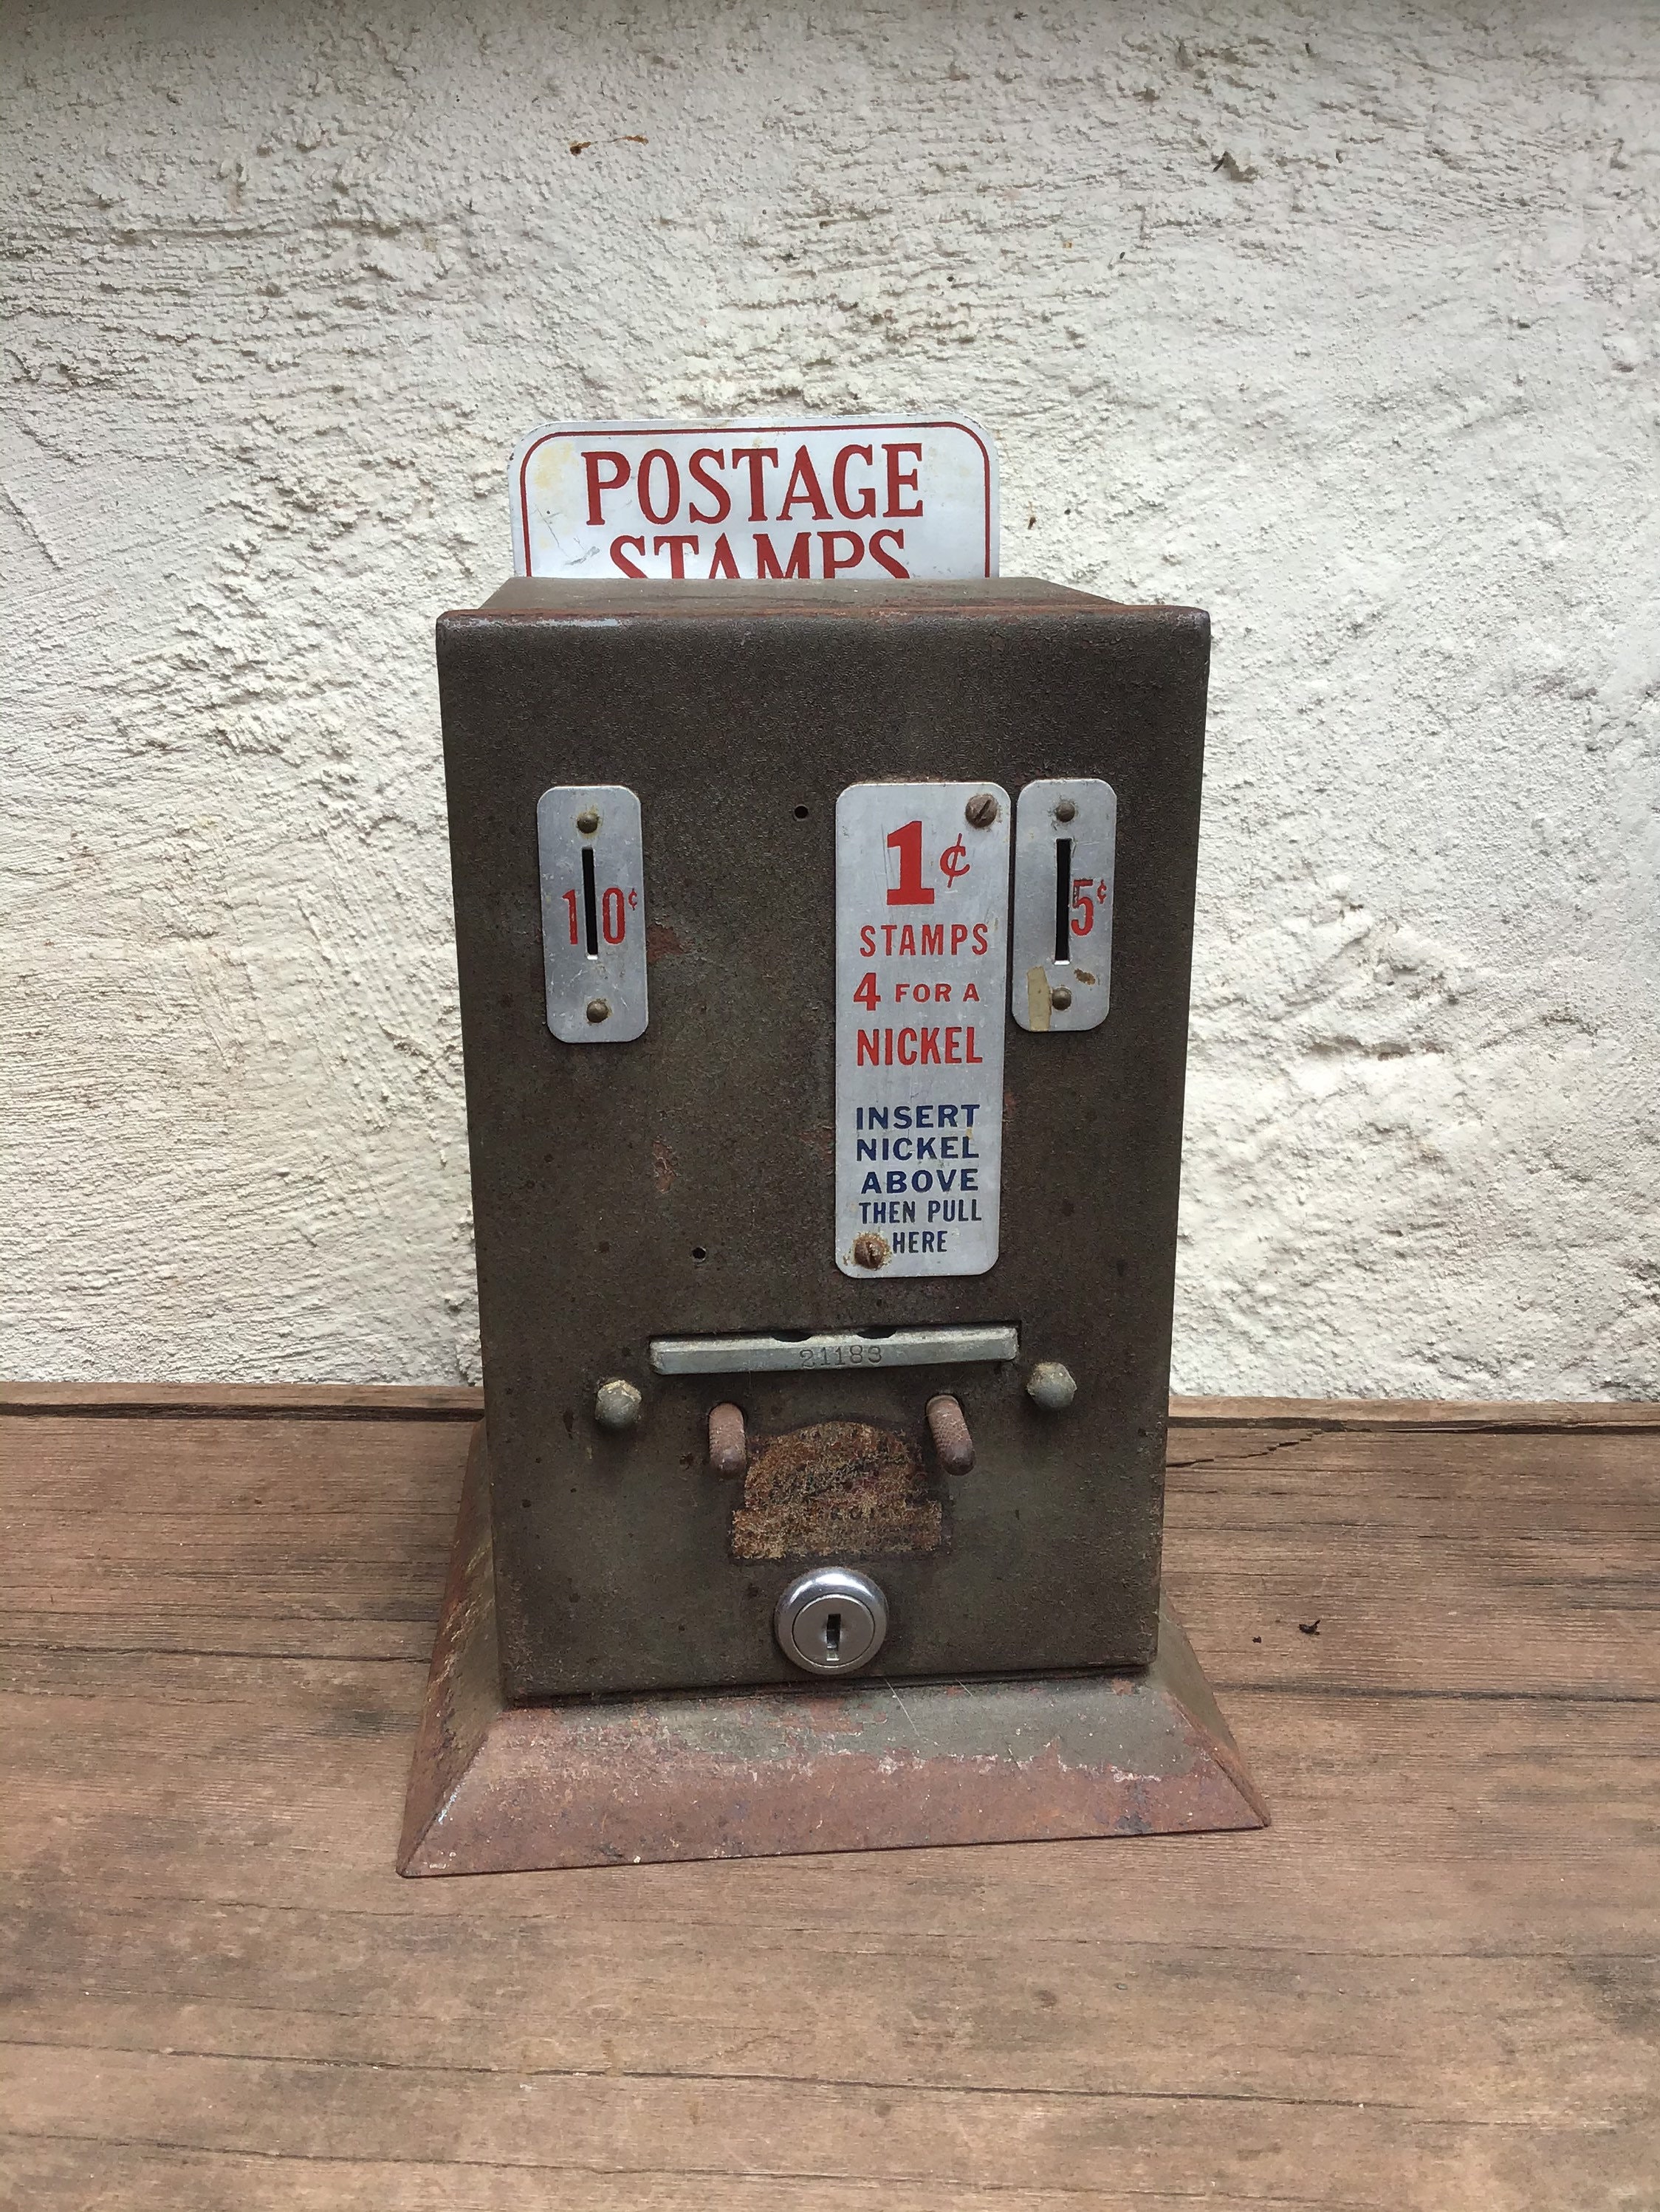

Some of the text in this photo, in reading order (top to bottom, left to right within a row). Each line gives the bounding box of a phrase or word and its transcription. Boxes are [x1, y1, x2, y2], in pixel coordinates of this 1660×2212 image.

[580, 442, 924, 526] POSTAGE
[610, 529, 910, 580] STAMPS
[1071, 879, 1107, 937] 5¢
[860, 923, 988, 957] STAMPS
[853, 972, 980, 1011] 4 FOR A
[857, 1026, 983, 1066] NICKEL
[856, 1104, 980, 1130] INSERT
[856, 1136, 979, 1161] NICKEL
[861, 1168, 978, 1195] ABOVE
[859, 1199, 982, 1224] THEN PULL
[892, 1230, 948, 1254] HERE
[799, 1344, 882, 1369] 21183
